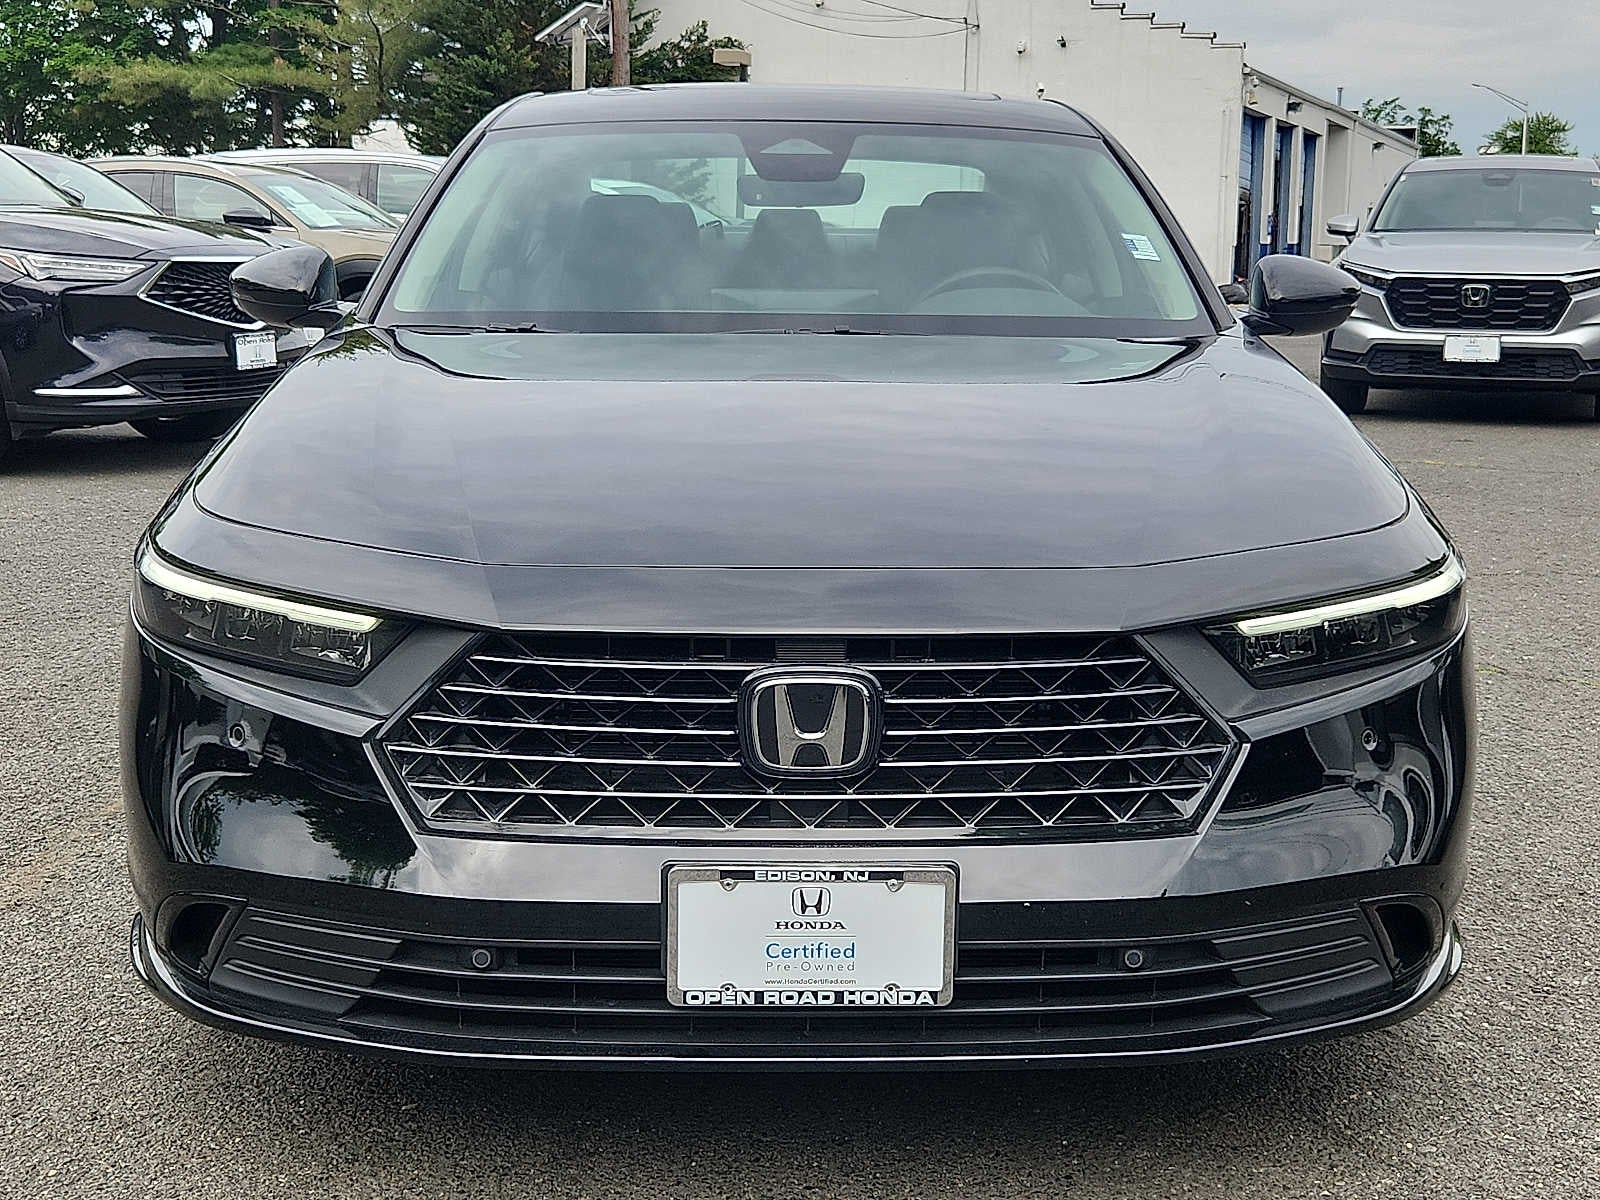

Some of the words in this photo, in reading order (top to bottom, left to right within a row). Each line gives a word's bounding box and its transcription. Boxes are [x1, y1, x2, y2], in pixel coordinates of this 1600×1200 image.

[754, 870, 836, 881] EDISON,
[843, 870, 869, 881] NJ
[775, 921, 847, 930] HONDA
[765, 942, 856, 959] Certified
[766, 961, 856, 972] Pre-Owned
[685, 991, 755, 1005] OPEN
[763, 991, 835, 1005] ROAD
[843, 991, 935, 1005] HONDA
